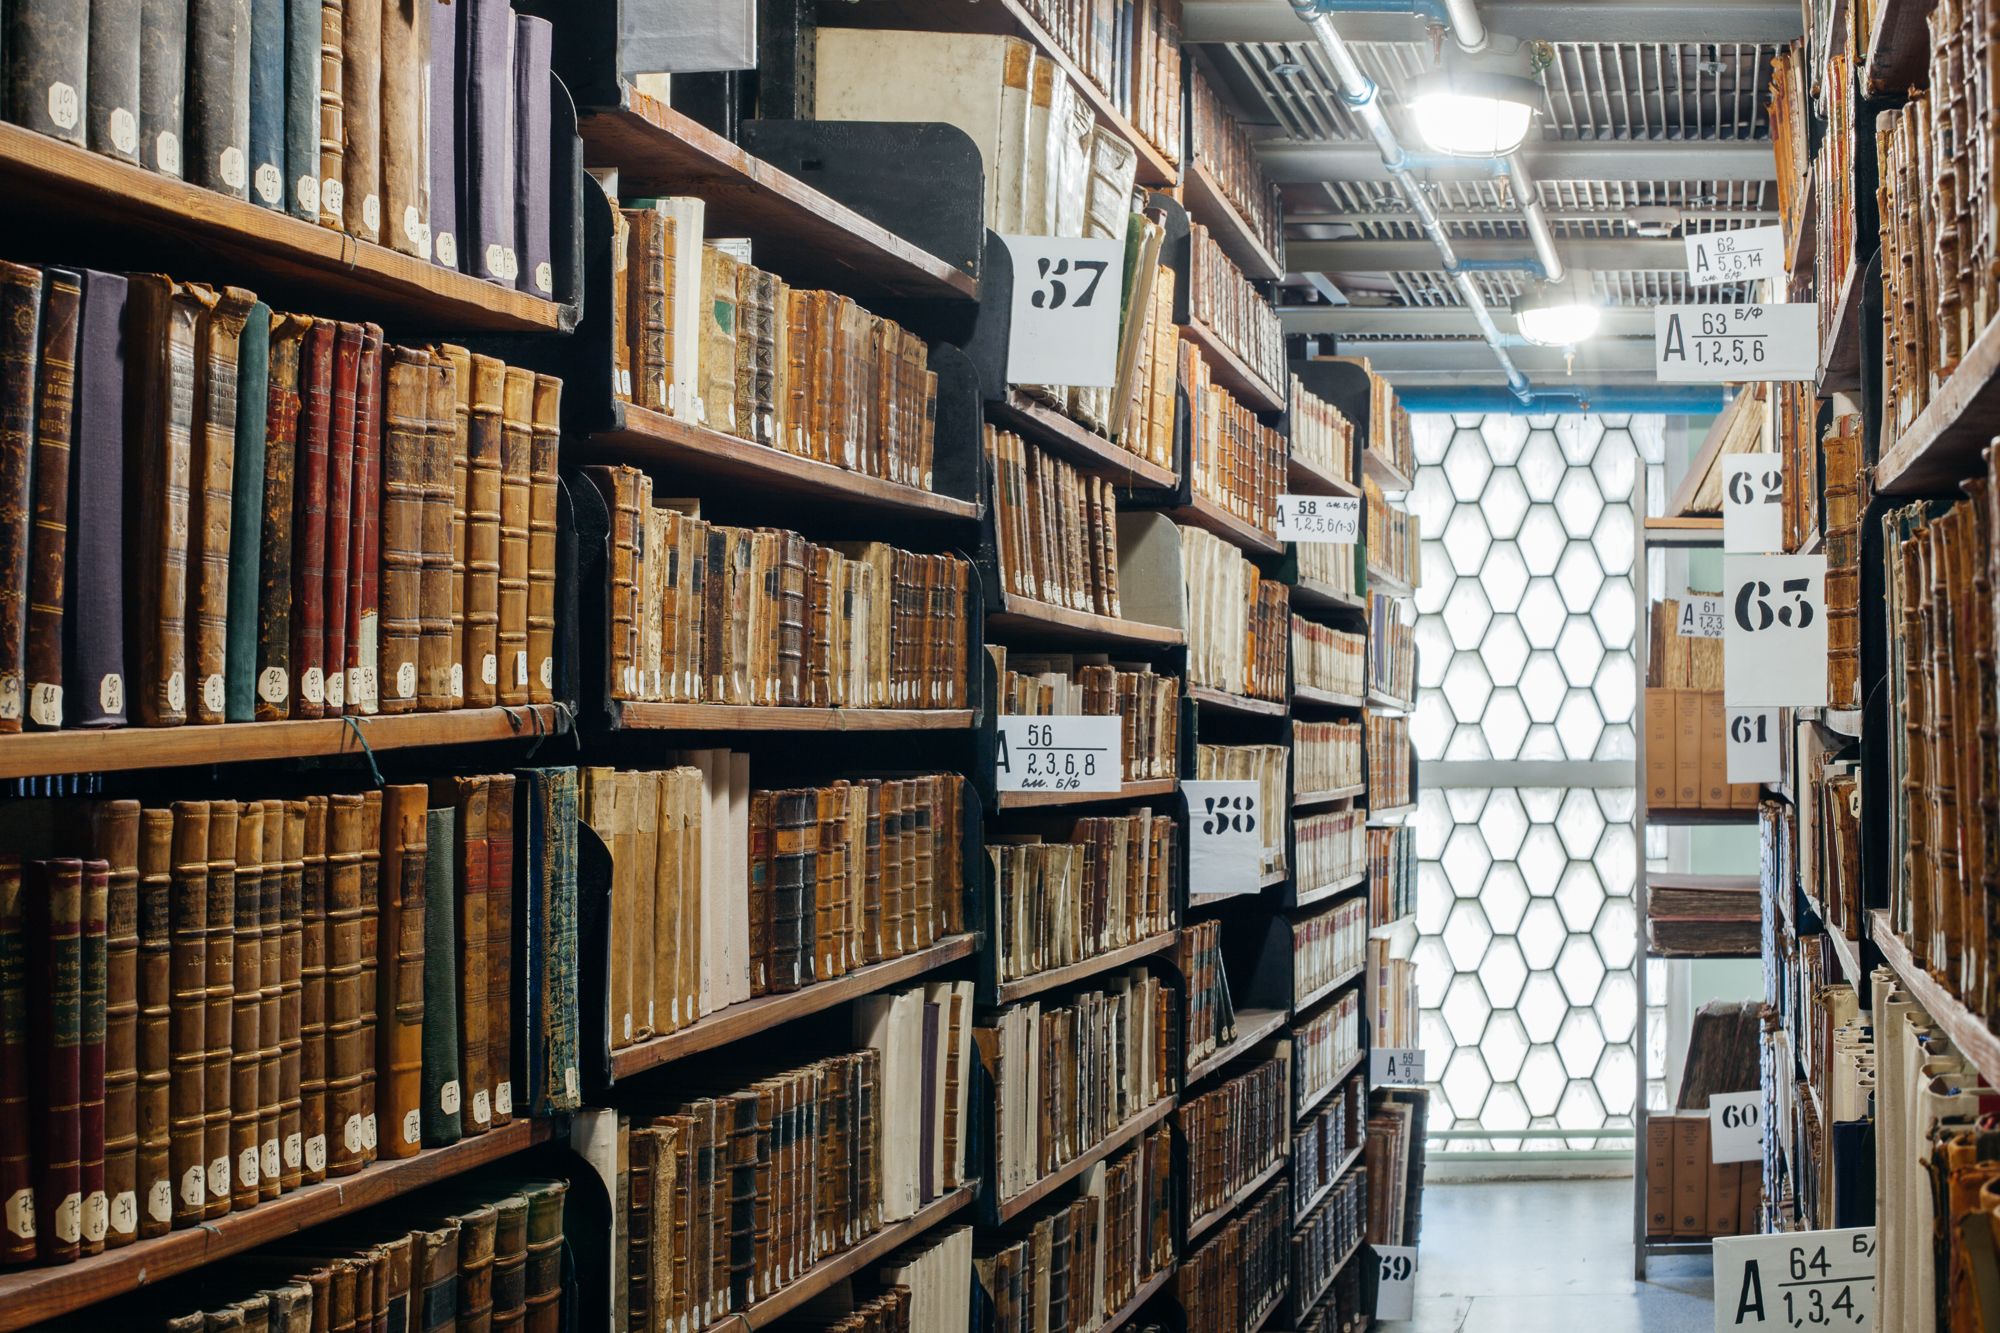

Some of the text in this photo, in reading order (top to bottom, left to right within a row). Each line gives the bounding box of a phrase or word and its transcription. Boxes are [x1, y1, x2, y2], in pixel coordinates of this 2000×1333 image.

[264, 168, 278, 184] 102
[1717, 236, 1735, 252] 62
[1031, 257, 1109, 310] 57
[1702, 306, 1764, 335] 63 Б/Ф
[1695, 338, 1765, 367] 1,2,5,6
[1728, 471, 1782, 505] 62
[1298, 500, 1316, 514] 58
[1703, 601, 1716, 613] 61
[1734, 577, 1814, 633] 63
[269, 669, 282, 685] 92
[1027, 724, 1053, 747] 56
[1731, 714, 1767, 744] 61
[1027, 752, 1096, 778] 2,3,6,8
[1056, 778, 1081, 790] Б/Ф
[1202, 796, 1256, 835] 58
[1402, 1052, 1414, 1064] 59
[1404, 1066, 1411, 1078] 8
[1722, 1103, 1759, 1129] 60
[1378, 1255, 1413, 1281] 59
[1789, 1245, 1832, 1281] 64
[1783, 1285, 1876, 1329] 1,3,4,
